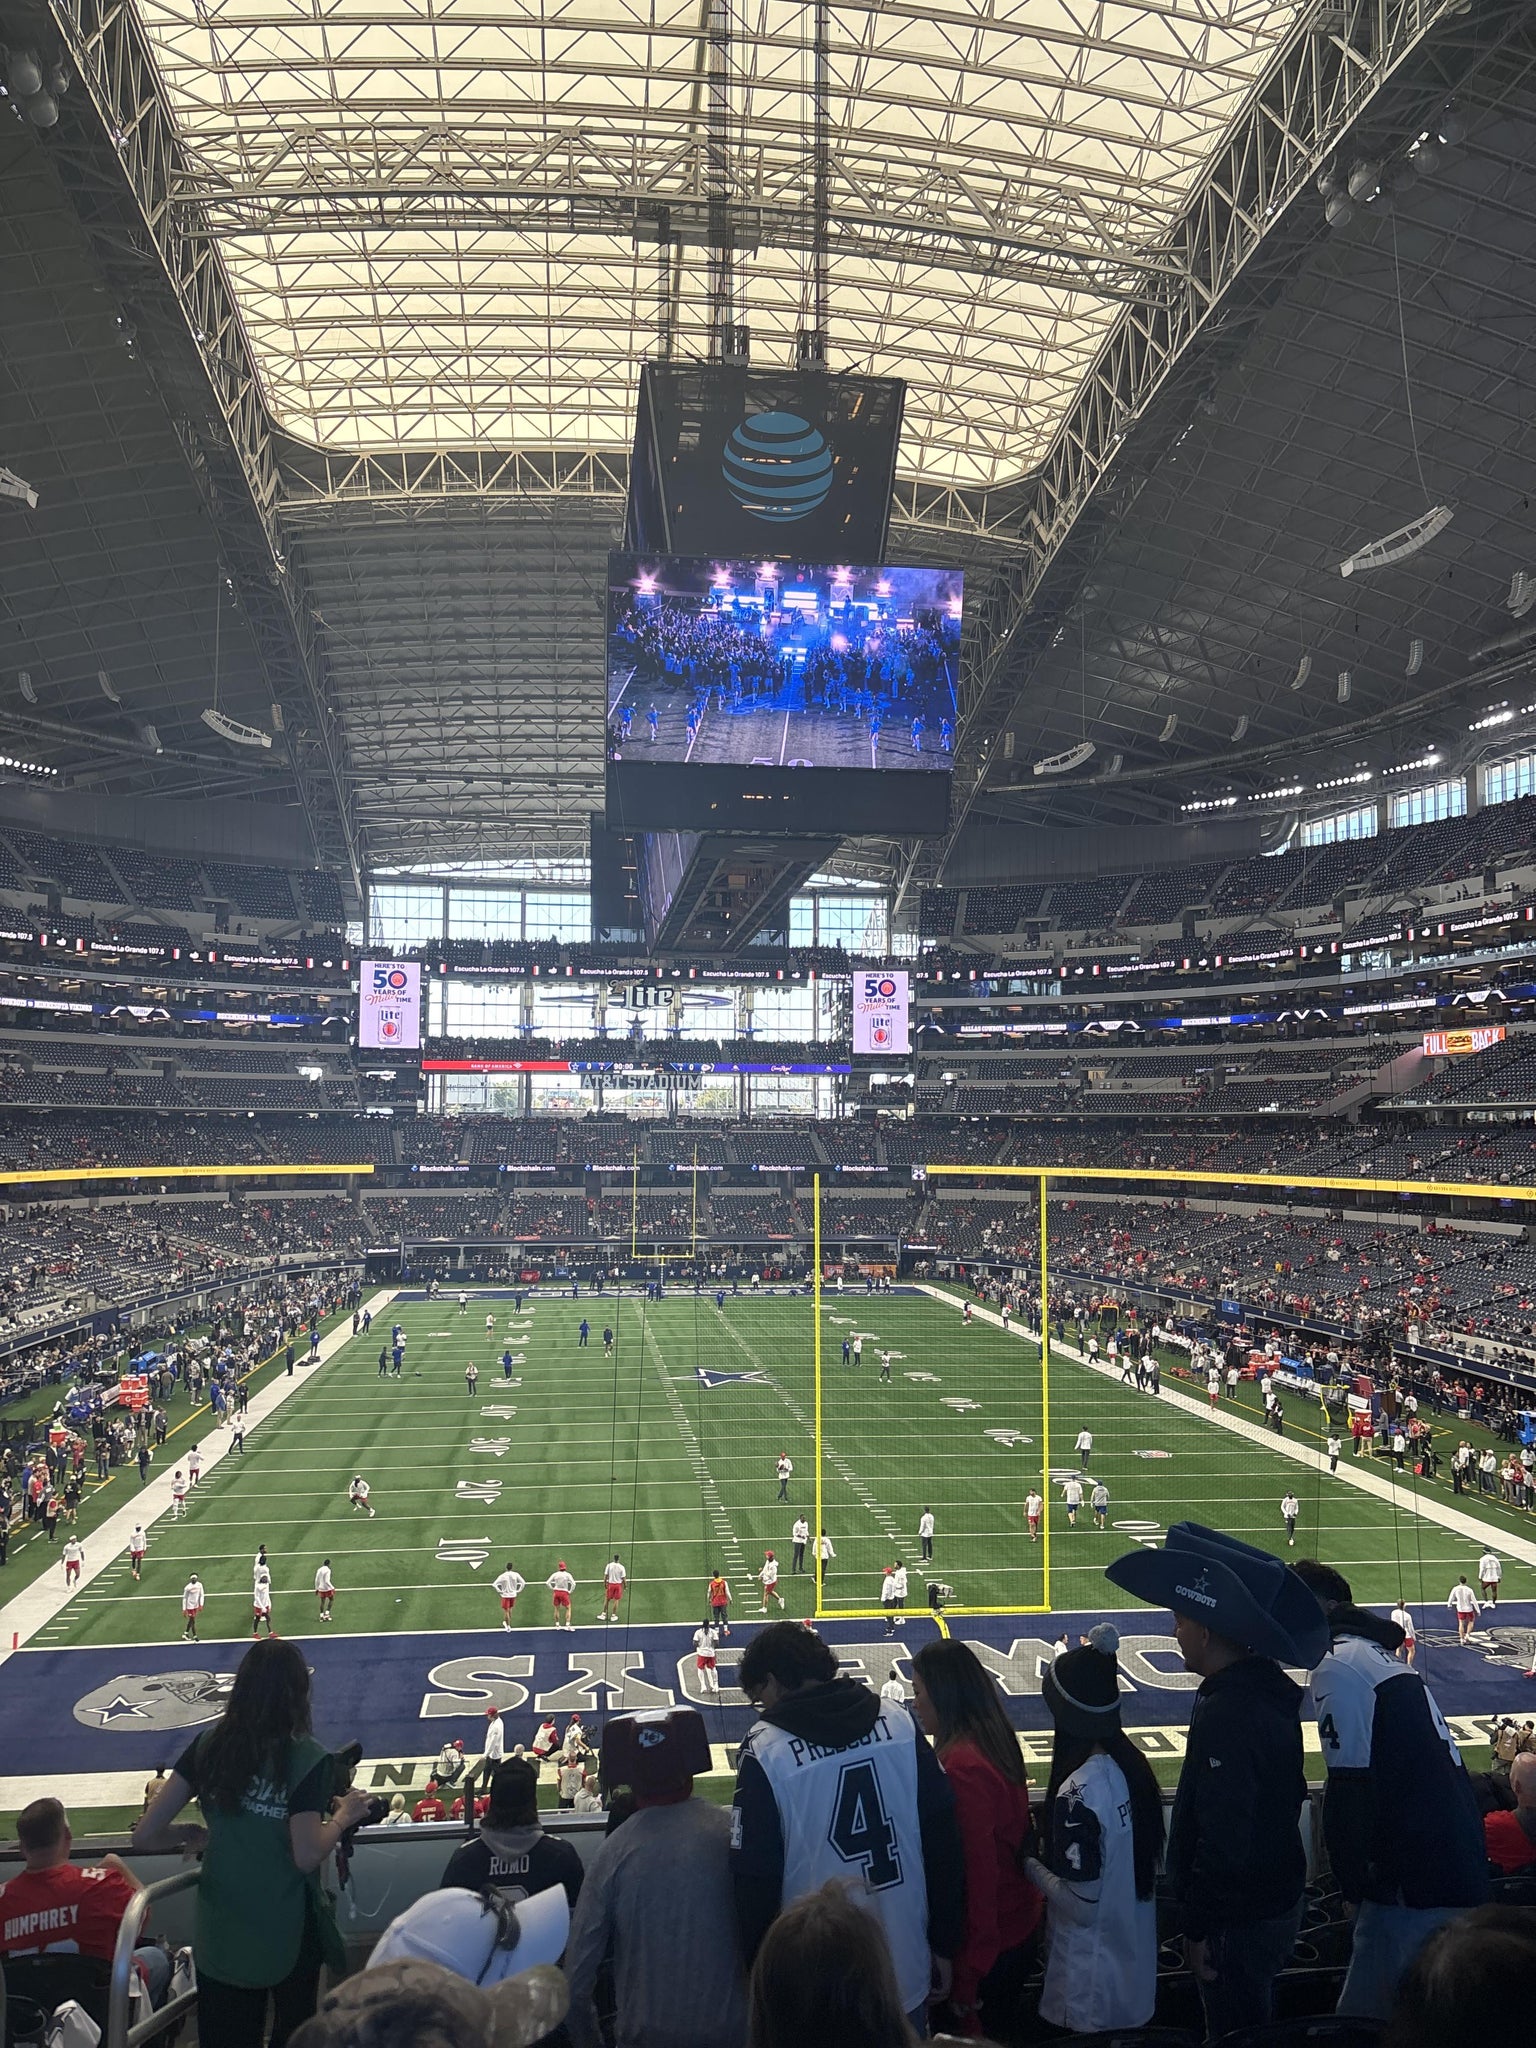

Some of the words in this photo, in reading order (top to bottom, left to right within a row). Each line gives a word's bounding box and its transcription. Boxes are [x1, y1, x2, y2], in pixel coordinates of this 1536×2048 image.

[1451, 921, 1475, 932] Escucha
[1475, 920, 1482, 928] La
[1482, 916, 1502, 926] Grande
[1503, 912, 1519, 922] 107.5
[0, 931, 17, 939] rande
[373, 970, 408, 989] 50
[865, 979, 897, 998] 50
[621, 985, 675, 1013] Lite
[381, 1010, 400, 1021] Lite
[872, 1018, 890, 1028] Lite
[1424, 1033, 1448, 1055] FULL
[1471, 1028, 1500, 1051] BACK
[581, 1074, 624, 1090] AT&T
[627, 1074, 702, 1090] STADIUM
[469, 1436, 512, 1452] 30
[455, 1479, 503, 1499] 20
[435, 1536, 493, 1562] 10
[1175, 1584, 1218, 1608] COWBOYS
[419, 1634, 1310, 1719] OWBOYS
[788, 1715, 893, 1767] PRTT
[1319, 1713, 1340, 1749] 4
[827, 1756, 904, 1896] 4
[489, 1854, 530, 1876] ROMO
[1064, 1842, 1081, 1871] 4
[4, 1904, 79, 1941] HUMPHREY
